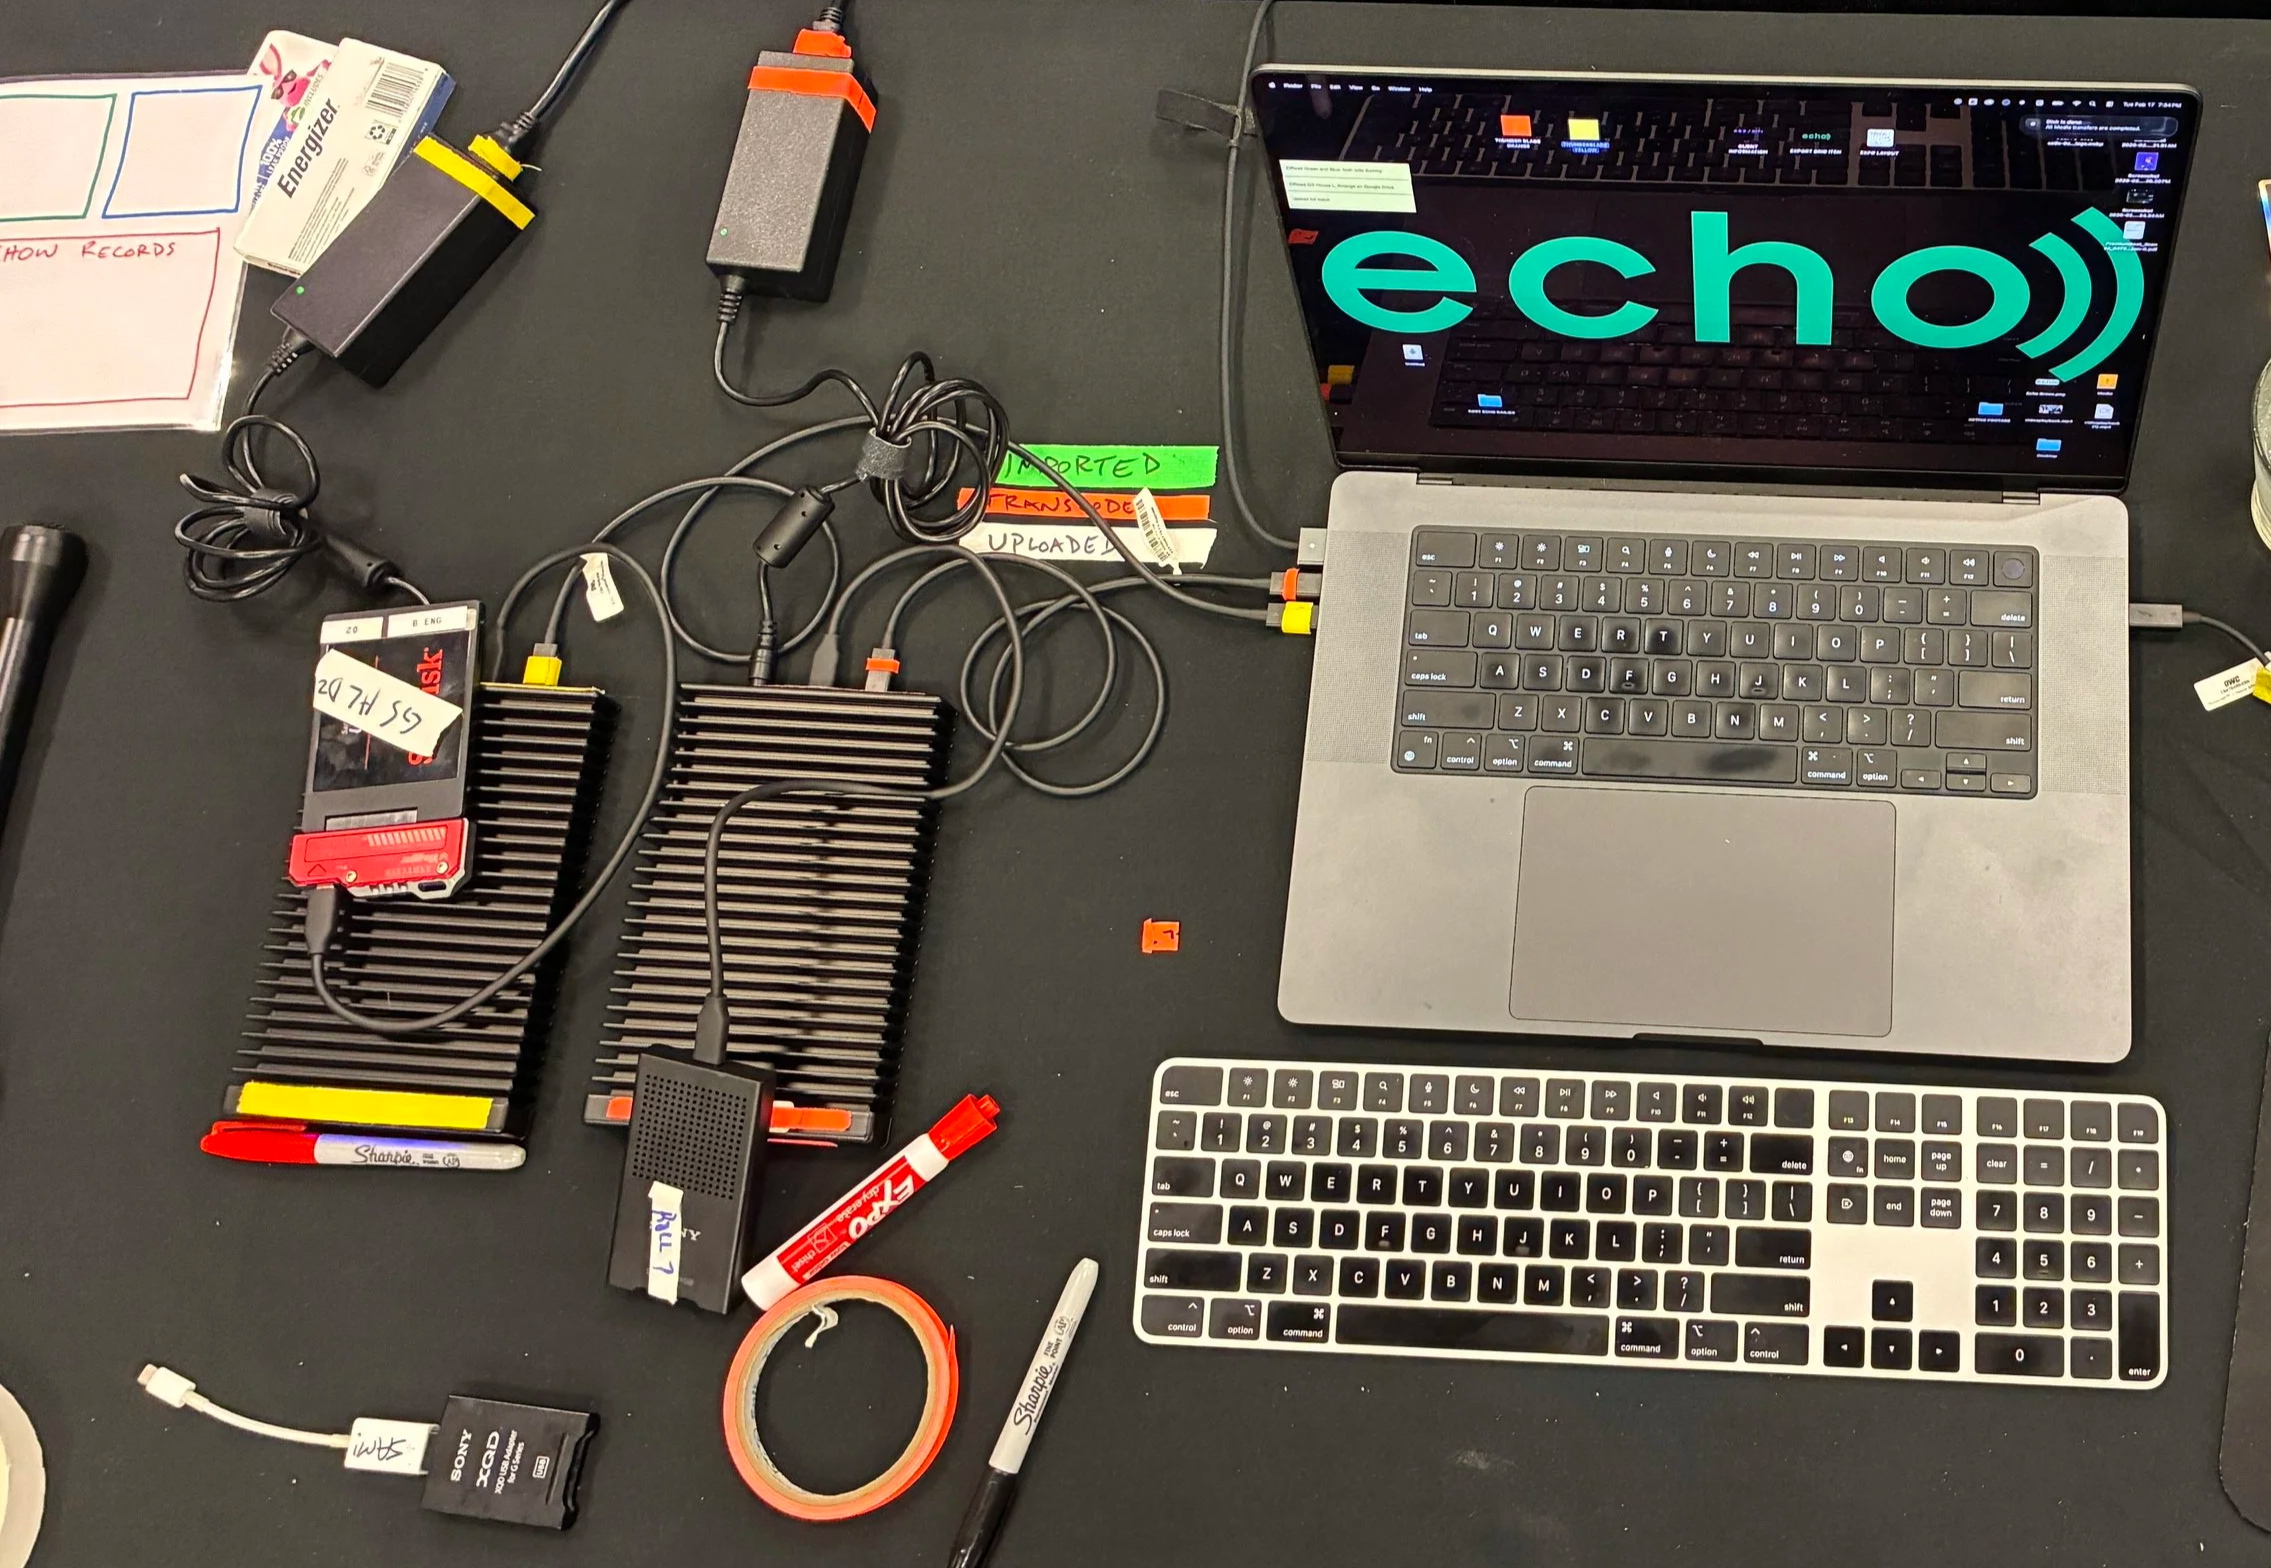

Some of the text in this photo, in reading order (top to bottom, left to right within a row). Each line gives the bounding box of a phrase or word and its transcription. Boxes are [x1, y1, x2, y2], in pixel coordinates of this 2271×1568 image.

[277, 97, 338, 198] Energizer
[0, 240, 175, 262] HOW RECORDS
[1322, 211, 2030, 350] echo
[424, 617, 442, 626] ENG
[1489, 625, 1497, 635] Q
[1530, 626, 1541, 636] W
[1575, 628, 1581, 638] E
[1617, 630, 1625, 640] R
[1660, 631, 1667, 641] T
[1704, 633, 1711, 643] Y
[1746, 635, 1754, 644] U
[1792, 636, 1794, 646] I
[1832, 638, 1840, 648] O
[1876, 639, 1884, 649] P
[1496, 665, 1504, 675] A
[1539, 667, 1546, 677] S
[1582, 669, 1590, 678] D
[1626, 670, 1633, 680] F
[1668, 672, 1676, 682] G
[1711, 674, 1719, 684] H
[1755, 675, 1762, 685] J
[1799, 677, 1806, 687] K
[1843, 679, 1849, 688] L
[1515, 707, 1522, 717] Z
[1558, 708, 1565, 718] X
[1601, 710, 1609, 720] C
[1644, 712, 1652, 722] V
[1688, 713, 1695, 723] B
[1731, 715, 1739, 725] N
[1774, 717, 1784, 727] M
[1493, 758, 1517, 766] option
[1863, 773, 1888, 781] option
[352, 1144, 415, 1165] Sharpie
[1884, 1155, 1906, 1163] home
[1932, 1153, 1951, 1161] page
[1782, 1161, 1806, 1169] delete
[1236, 1173, 1244, 1186] Q
[1280, 1175, 1292, 1187] W
[1328, 1177, 1335, 1188] E
[1373, 1179, 1381, 1190] R
[1157, 1182, 1170, 1190] tab
[1419, 1181, 1426, 1192] T
[1465, 1182, 1473, 1194] Y
[1510, 1184, 1519, 1196] U
[1559, 1186, 1562, 1197] I
[1602, 1188, 1611, 1199] O
[1649, 1189, 1657, 1201] P
[848, 1174, 914, 1240] EXPO
[1931, 1199, 1951, 1207] page
[1930, 1209, 1952, 1217] down
[1243, 1220, 1251, 1231] A
[1289, 1222, 1297, 1234] S
[1335, 1224, 1344, 1235] D
[1174, 1229, 1189, 1237] lock
[1382, 1226, 1389, 1237] F
[1427, 1227, 1435, 1239] G
[1473, 1230, 1482, 1241] H
[1520, 1232, 1526, 1243] J
[1566, 1233, 1573, 1245] K
[1613, 1235, 1619, 1247] L
[791, 1250, 816, 1272] chisel
[1263, 1268, 1271, 1279] Z
[1309, 1270, 1317, 1281] X
[1355, 1271, 1363, 1283] C
[1150, 1275, 1167, 1283] shift
[1401, 1273, 1410, 1285] V
[1447, 1275, 1455, 1287] B
[1493, 1277, 1502, 1289] N
[1539, 1279, 1549, 1291] M
[1785, 1303, 1803, 1311] shift
[1228, 1326, 1253, 1335] option
[1043, 1341, 1054, 1356] FINE
[1050, 1338, 1063, 1358] POINT
[1621, 1345, 1660, 1353] command
[1691, 1348, 1717, 1356] option
[1750, 1350, 1778, 1358] control
[2129, 1368, 2150, 1376] enter
[1013, 1365, 1053, 1435] Sharpie
[503, 1429, 518, 1460] Adapter
[450, 1429, 472, 1482] SONY
[476, 1431, 500, 1488] XQD
[507, 1441, 525, 1484] for G Series
[499, 1460, 510, 1476] USB
